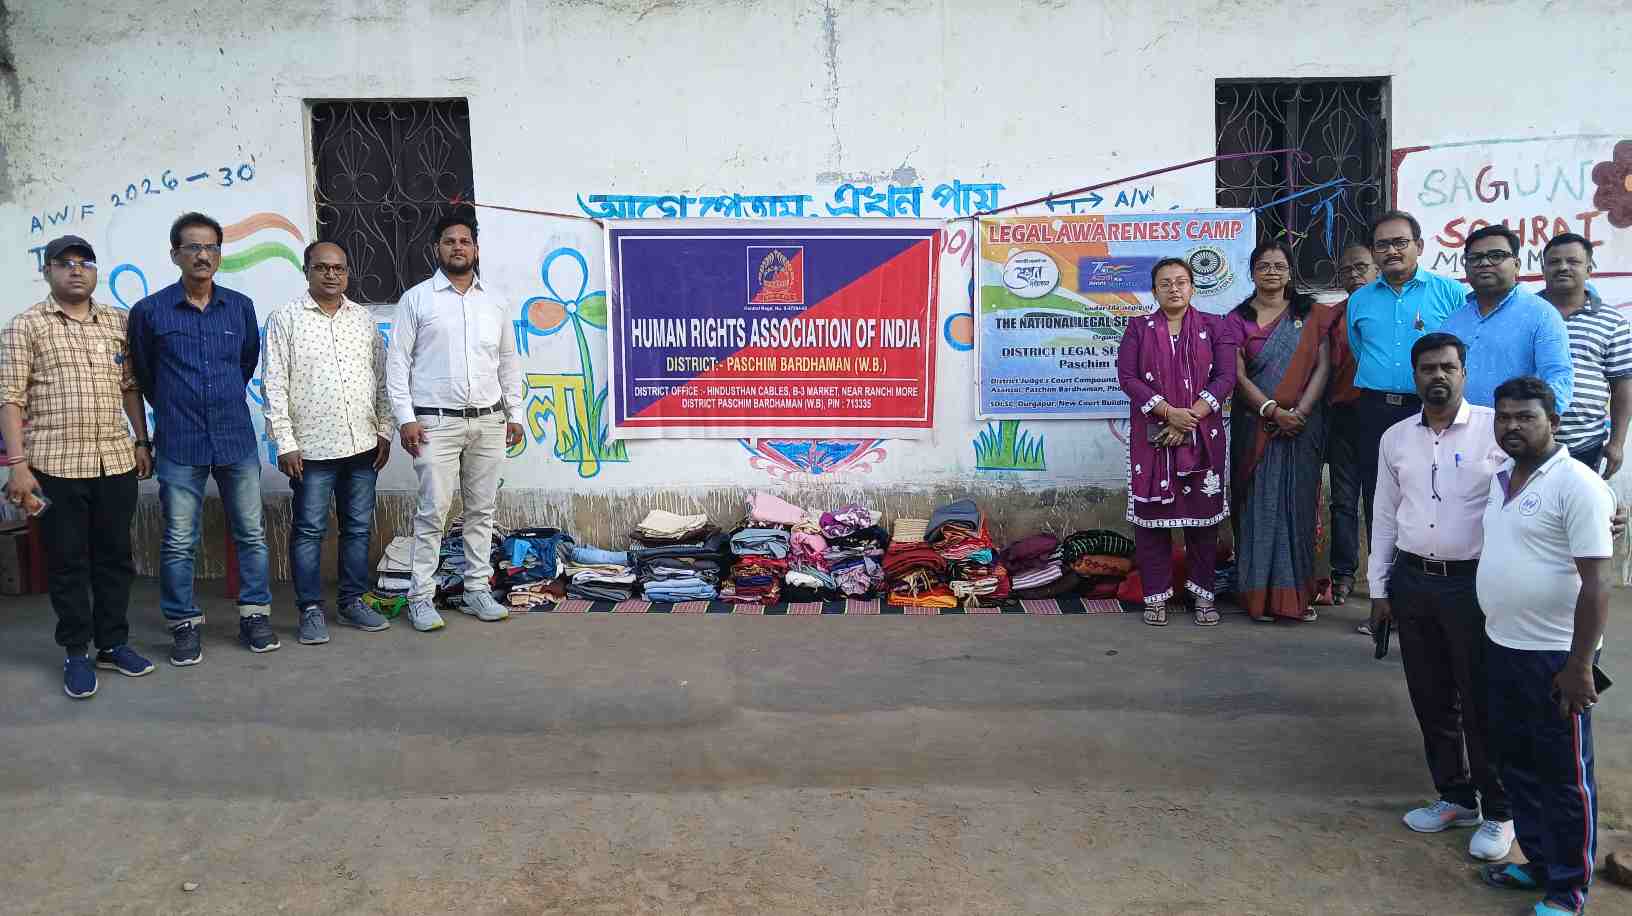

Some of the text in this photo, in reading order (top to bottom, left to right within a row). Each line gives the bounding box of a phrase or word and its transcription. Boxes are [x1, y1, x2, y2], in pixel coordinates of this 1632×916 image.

[1418, 160, 1593, 206] SAGUN
[577, 192, 696, 217] আগে
[825, 183, 923, 217] এখন
[989, 220, 1243, 243] LEGAL AWARENESS CAMP
[996, 316, 1128, 329] THE NATIONAL LEGAL SE
[632, 318, 920, 348] HUMAN RIGHTS ASSOCIATION OF INDIA
[1002, 346, 1119, 357] DISTRICT LEGAL SE
[727, 356, 777, 371] PASCHIM
[780, 356, 851, 372] BARDHAMAN
[855, 357, 887, 375] (W.B.)
[1060, 360, 1110, 369] Paschim
[635, 386, 669, 397] DISTRICT
[671, 386, 698, 396] OFFICE
[707, 386, 756, 396] HINDUSTHAN
[758, 386, 790, 397] CABLES,
[793, 386, 804, 396] B-3
[842, 386, 865, 397] NEAR
[865, 387, 894, 397] RANCHI
[896, 387, 919, 397] MORE
[682, 399, 716, 408] DISTRICT
[718, 399, 751, 408] PASCHIM
[754, 399, 802, 408] BARDHAMAN
[828, 399, 840, 408] PIN
[846, 399, 872, 408] 713335
